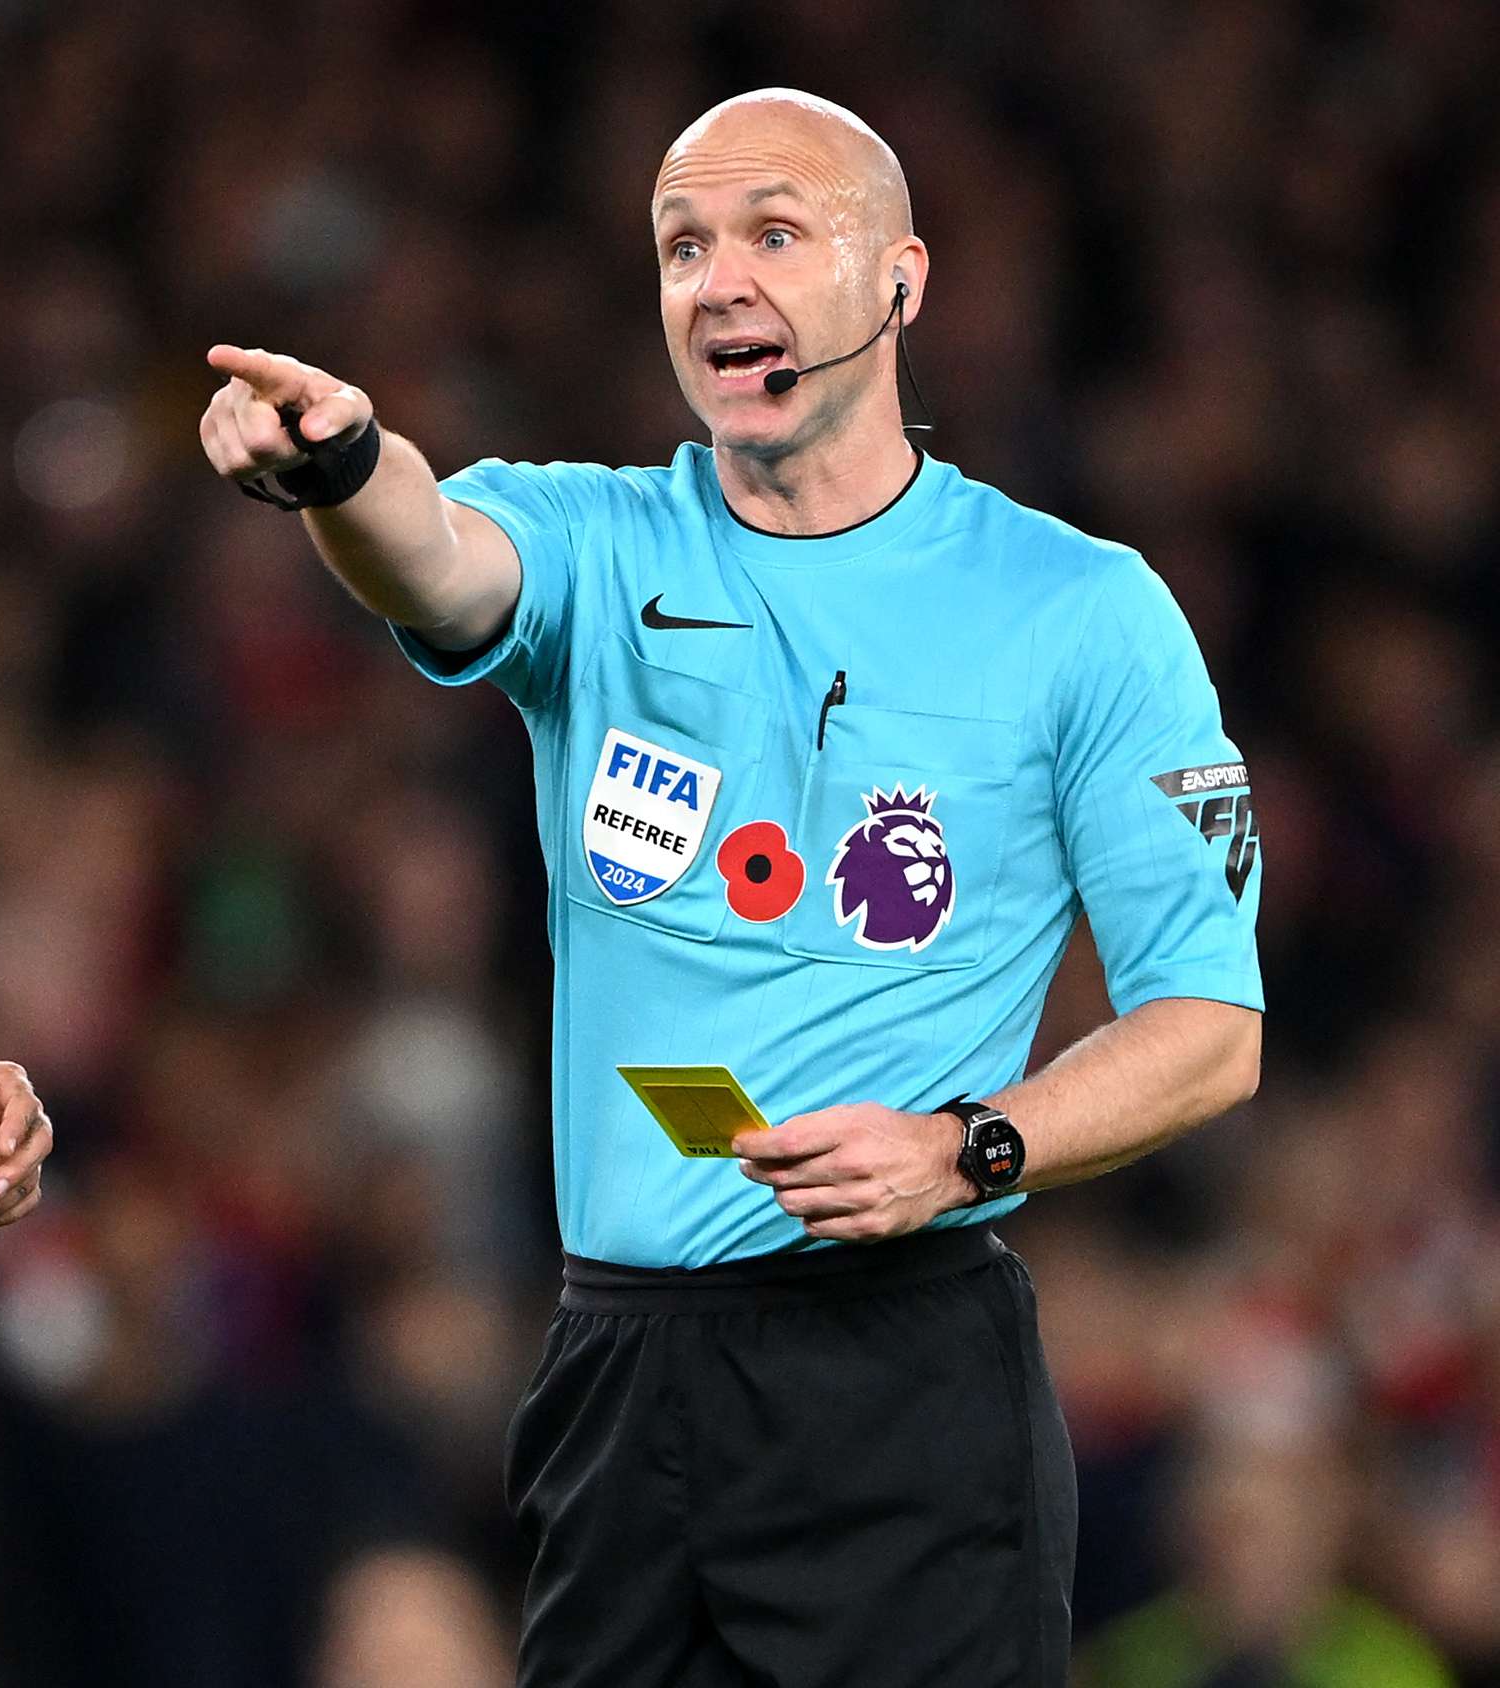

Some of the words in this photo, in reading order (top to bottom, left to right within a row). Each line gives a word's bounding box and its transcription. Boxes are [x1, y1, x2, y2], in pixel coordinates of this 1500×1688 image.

[607, 742, 698, 811] FIFA
[1203, 765, 1249, 787] SPORT
[593, 804, 688, 855] REFEREE
[602, 863, 647, 893] 2024
